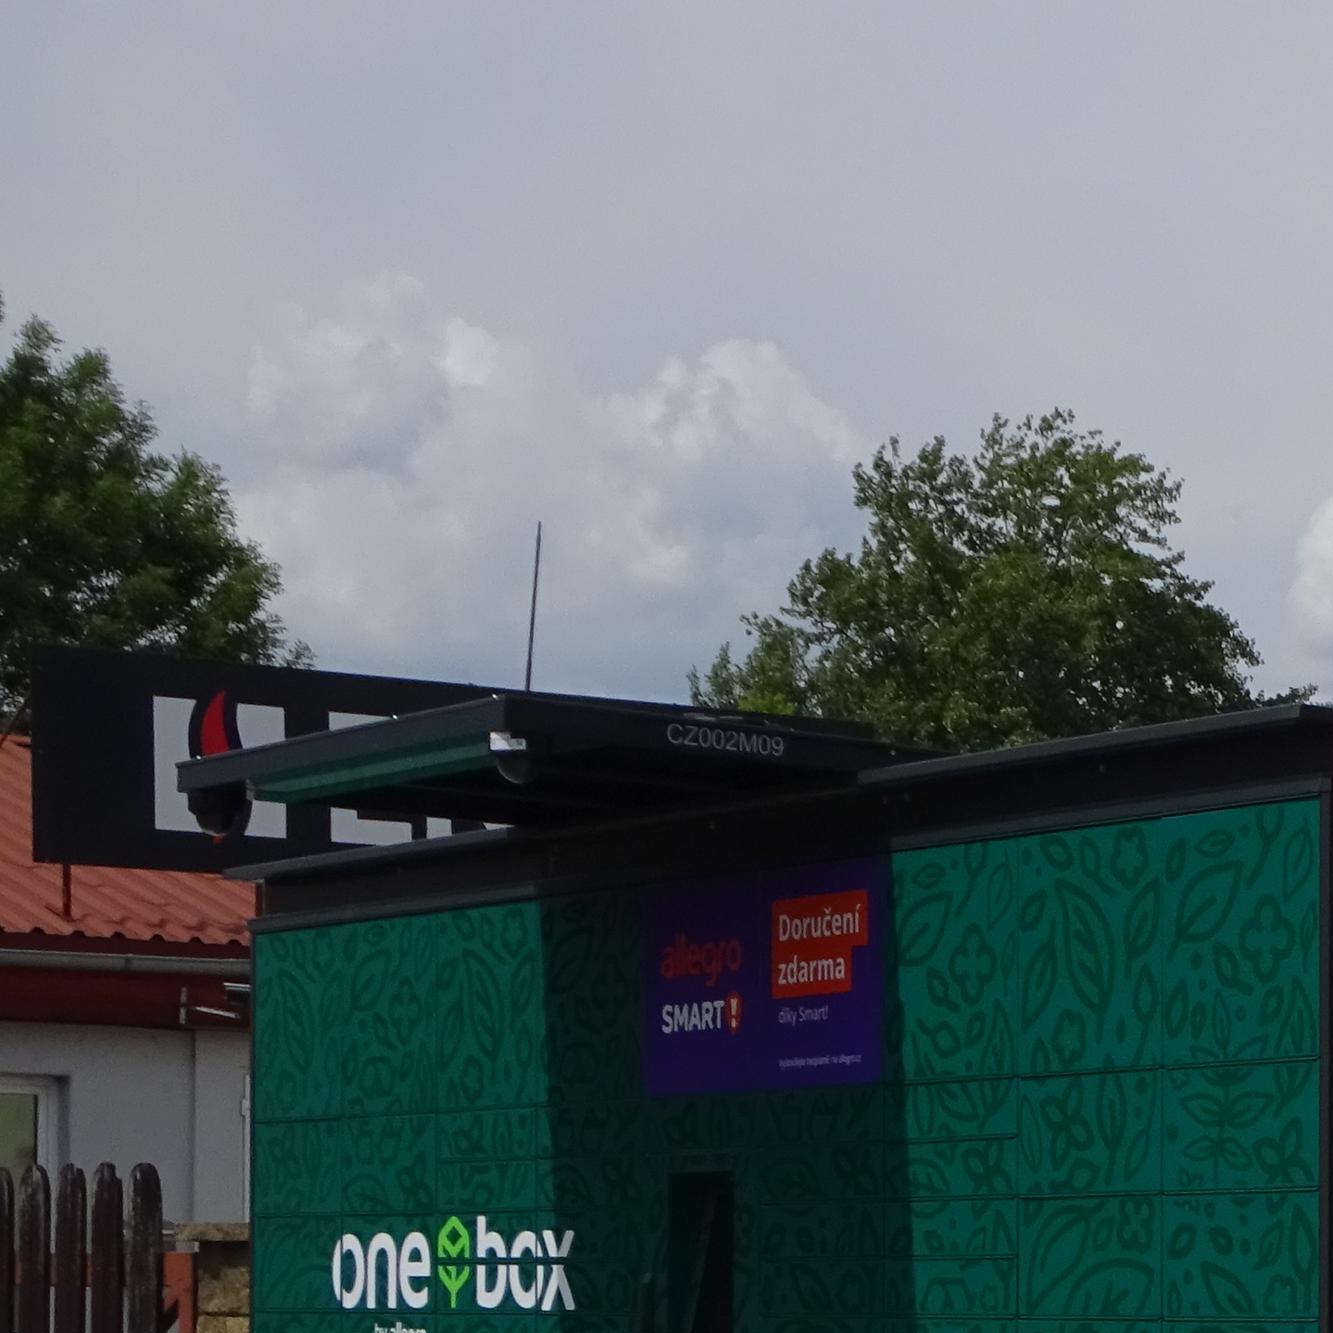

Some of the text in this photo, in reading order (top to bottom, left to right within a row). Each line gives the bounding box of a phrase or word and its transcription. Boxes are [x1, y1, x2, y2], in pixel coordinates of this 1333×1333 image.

[667, 723, 785, 757] CZ002M09
[778, 904, 861, 941] Doručení
[660, 933, 742, 987] allegro
[777, 955, 846, 985] zdarma
[332, 1215, 575, 1310] one box
